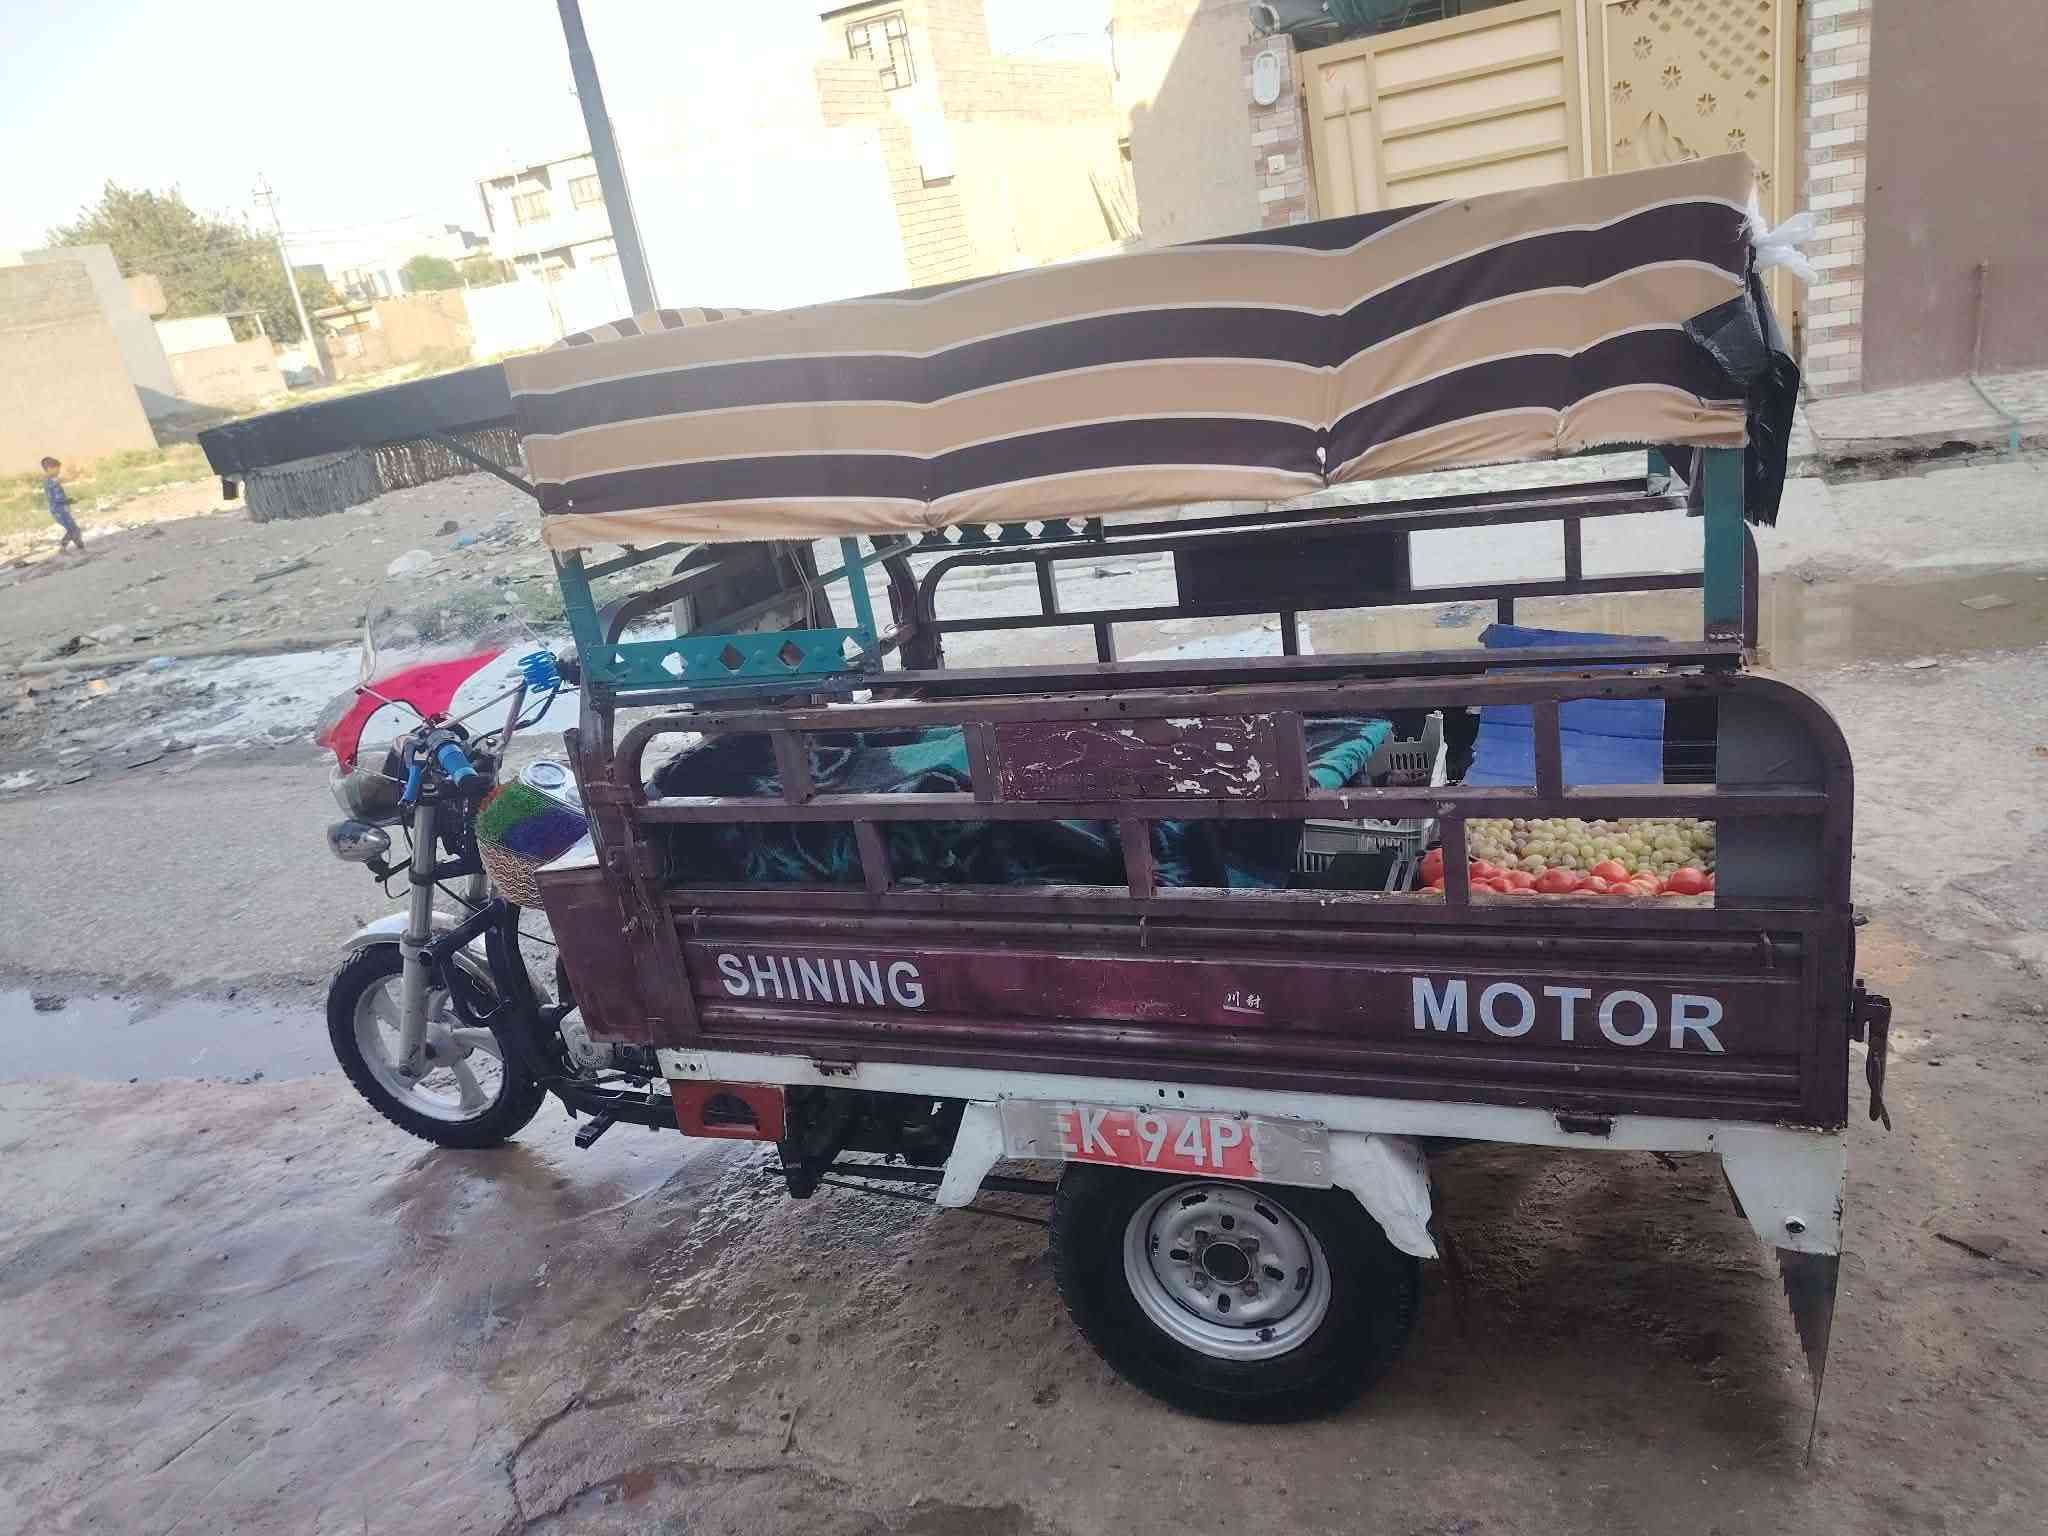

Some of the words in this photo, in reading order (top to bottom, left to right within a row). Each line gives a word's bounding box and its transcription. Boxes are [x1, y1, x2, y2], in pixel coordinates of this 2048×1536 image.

[717, 953, 925, 1008] SHINING
[1412, 977, 1726, 1053] MOTOR
[1056, 1106, 1262, 1173] EK-94P
